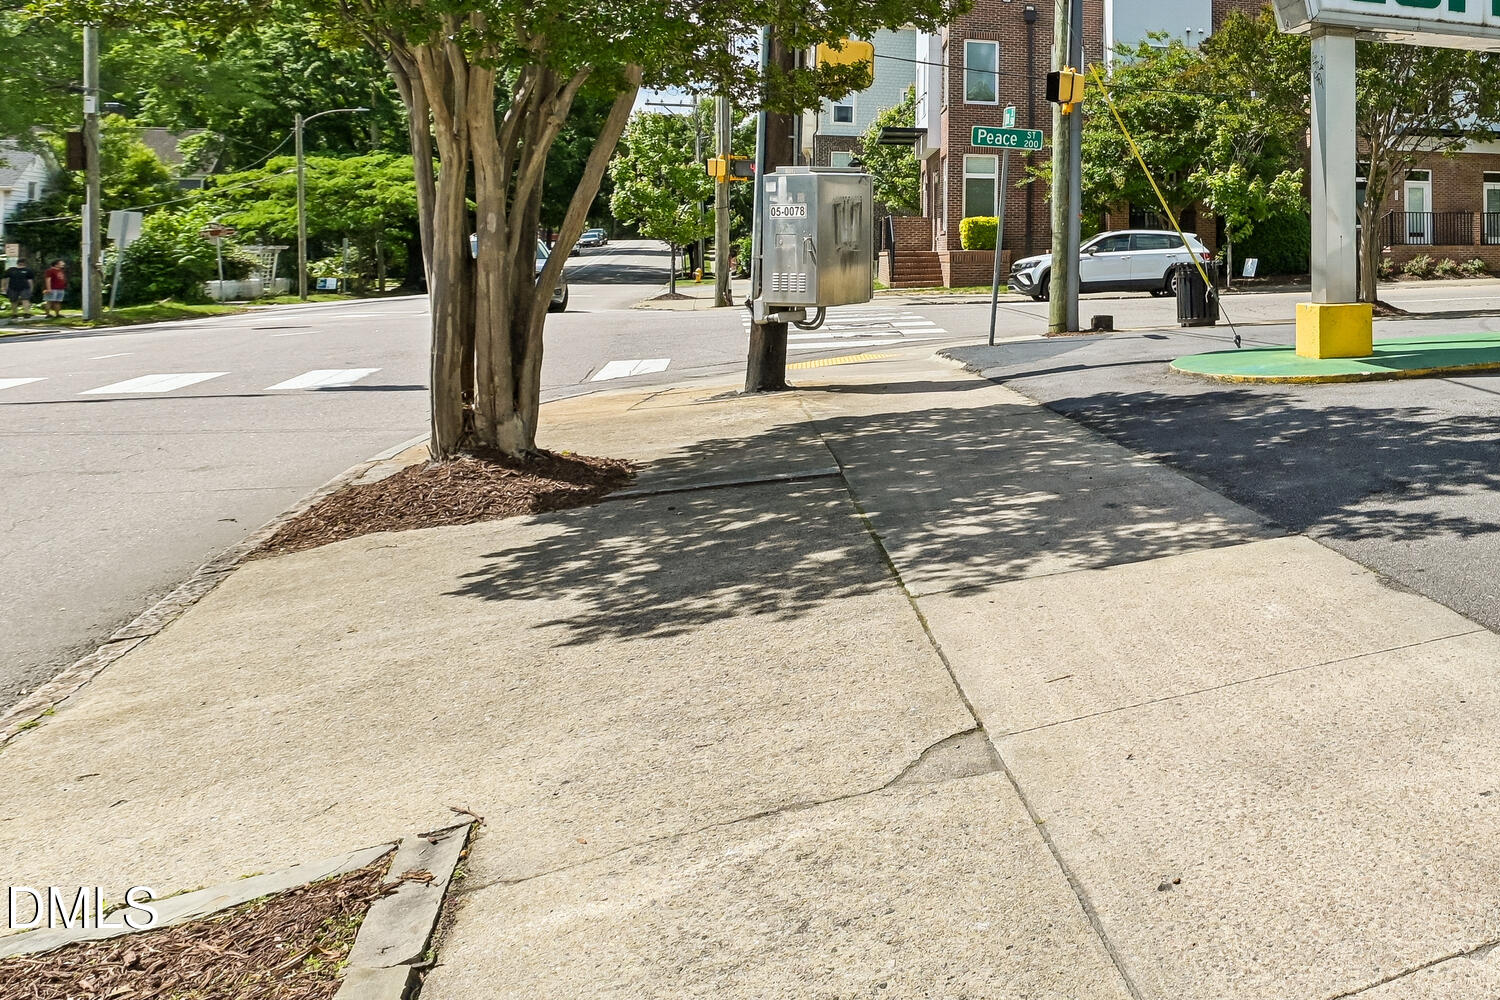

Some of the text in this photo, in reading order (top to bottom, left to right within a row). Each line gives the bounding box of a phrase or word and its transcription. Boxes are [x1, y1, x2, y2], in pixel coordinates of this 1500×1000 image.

[977, 129, 1036, 146] Peace ST
[1024, 140, 1039, 148] 200
[771, 206, 805, 216] 05-0078
